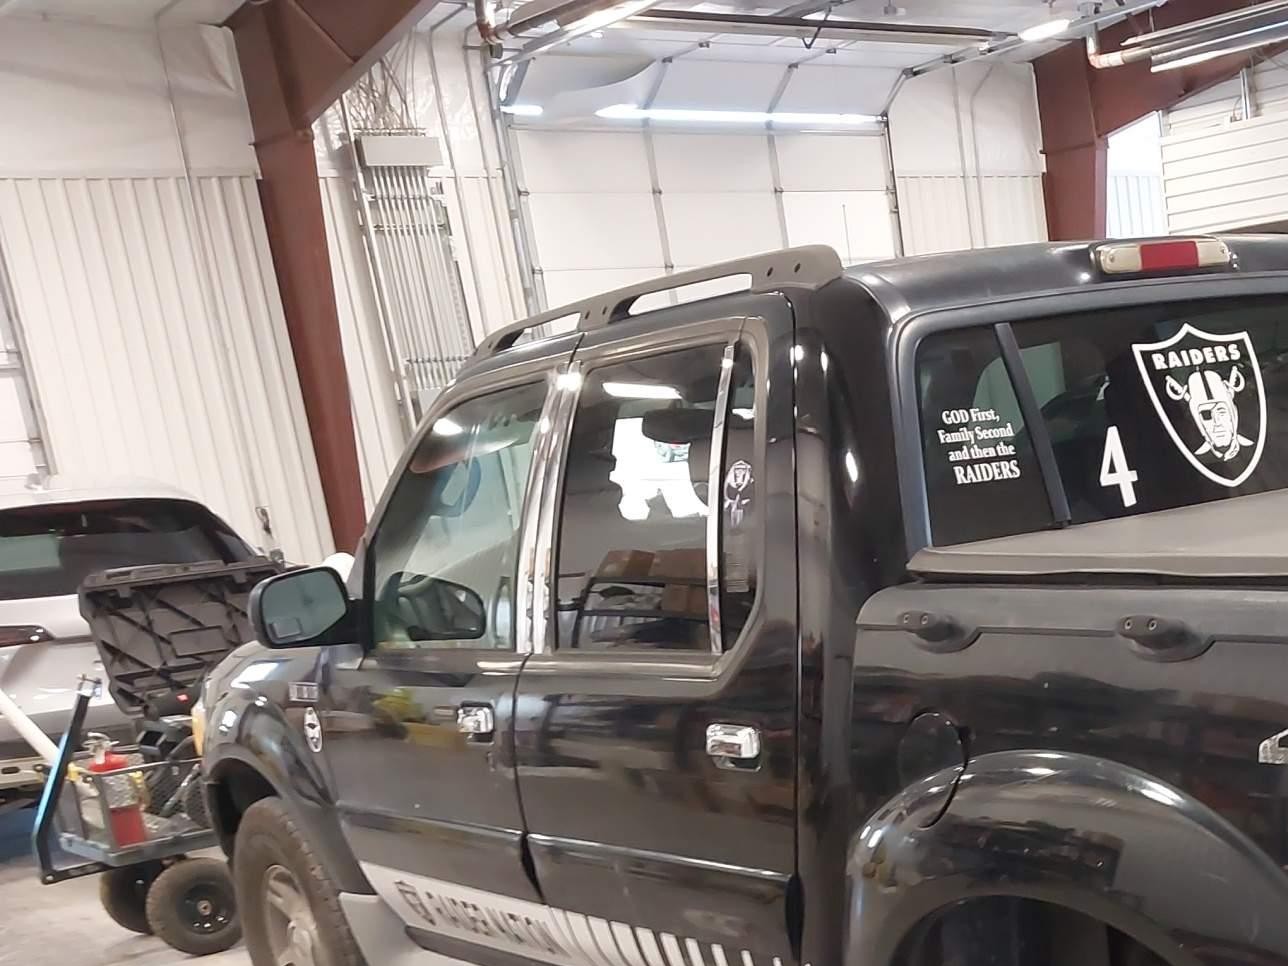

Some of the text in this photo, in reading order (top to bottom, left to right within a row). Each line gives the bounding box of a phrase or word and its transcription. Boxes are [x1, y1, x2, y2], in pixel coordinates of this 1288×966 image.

[1151, 344, 1241, 371] RAIDERS
[941, 408, 1000, 425] GOD First,
[937, 423, 1015, 445] Family Second
[948, 441, 1017, 462] and then the
[953, 459, 1021, 485] RAIDERS
[1099, 425, 1139, 508] 4
